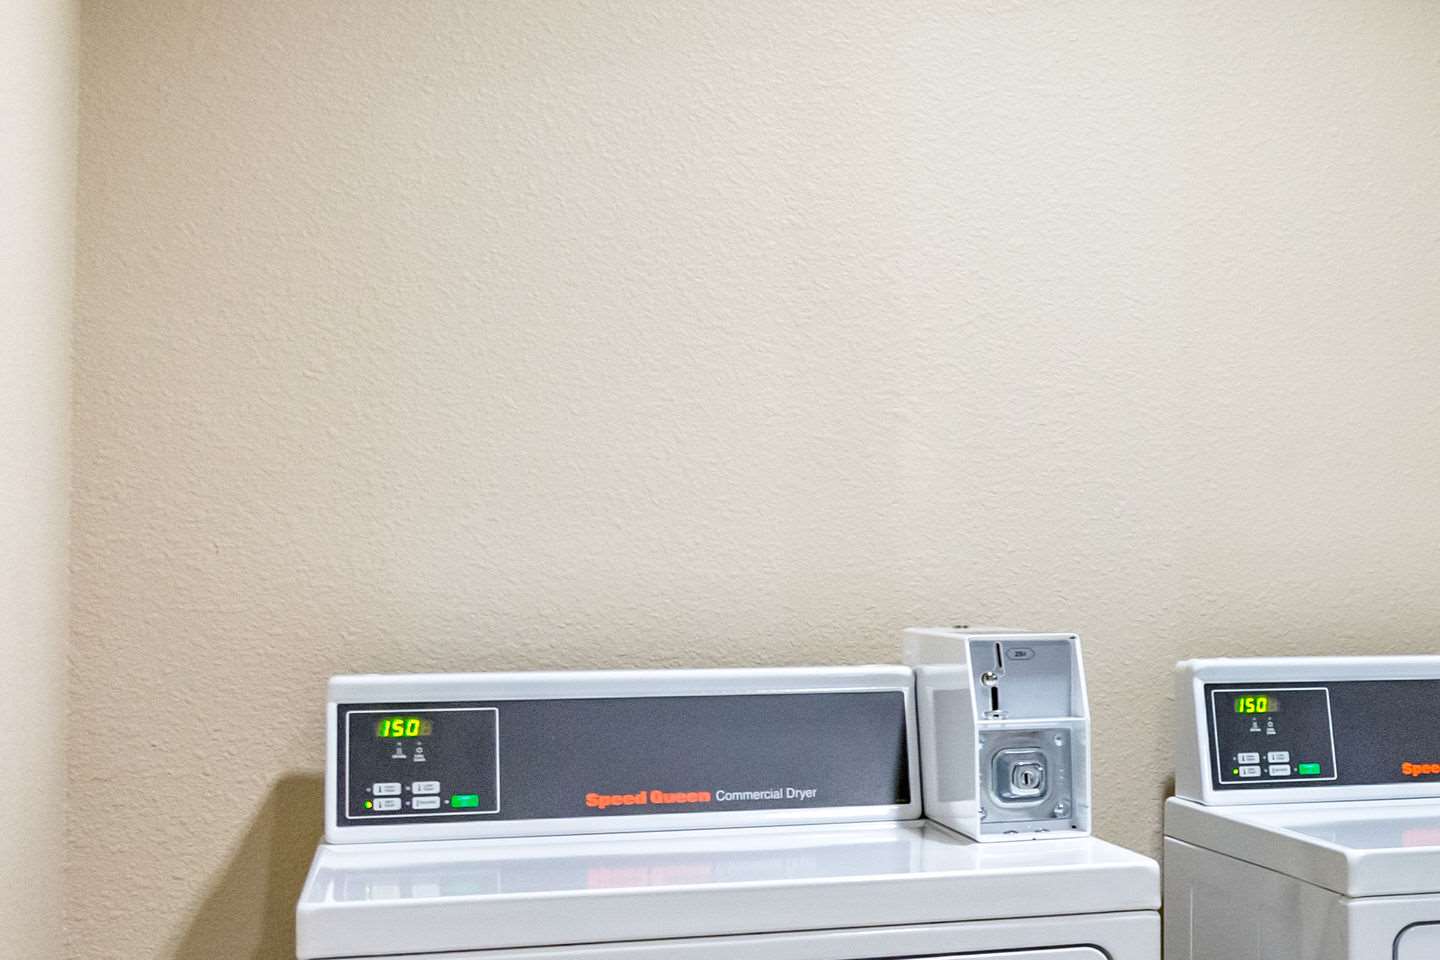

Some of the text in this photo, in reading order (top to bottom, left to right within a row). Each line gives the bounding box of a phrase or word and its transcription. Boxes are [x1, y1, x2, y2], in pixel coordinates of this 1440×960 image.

[1239, 697, 1267, 713] 150
[384, 719, 420, 736] 150
[585, 787, 817, 809] Speed Queen Commercial Dryer
